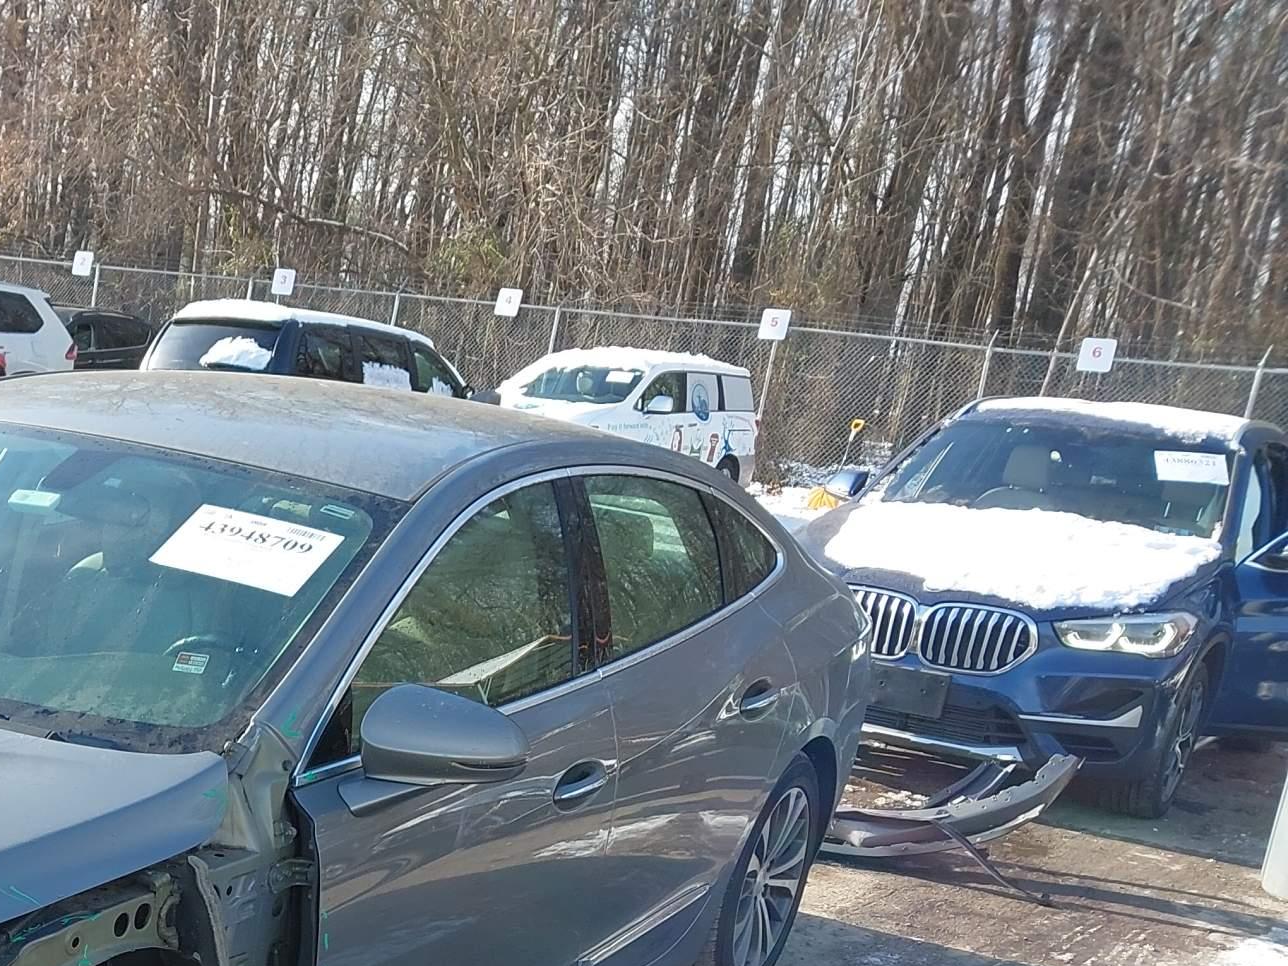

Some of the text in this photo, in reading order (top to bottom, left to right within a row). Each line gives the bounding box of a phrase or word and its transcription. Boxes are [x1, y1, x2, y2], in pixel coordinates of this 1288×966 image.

[769, 316, 780, 328] 5
[1092, 346, 1103, 359] 6
[200, 521, 313, 554] 43948709
